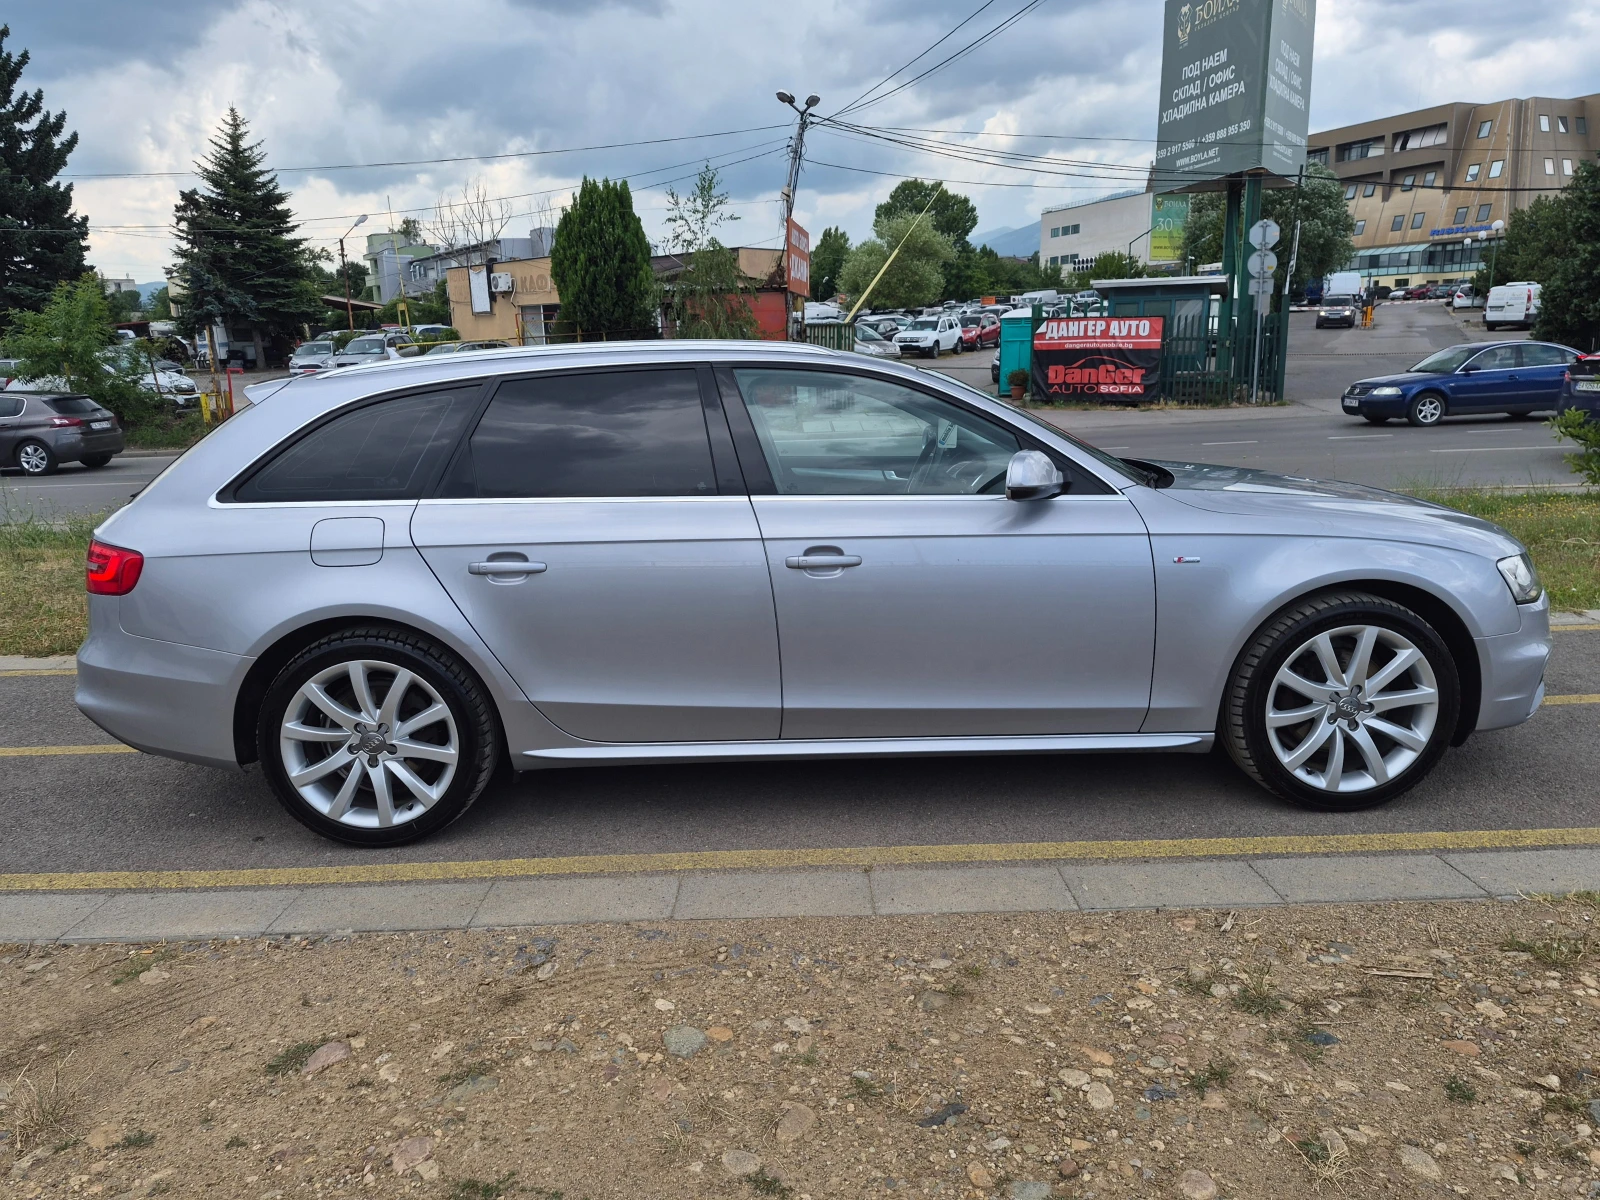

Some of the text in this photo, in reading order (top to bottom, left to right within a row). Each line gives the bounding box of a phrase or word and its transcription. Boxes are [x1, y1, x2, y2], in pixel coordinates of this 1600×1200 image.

[1182, 48, 1228, 80] ПОД НАЕМ
[1172, 82, 1201, 103] СКЛАД
[1208, 65, 1236, 89] ОФИС
[1161, 80, 1245, 125] ХЛАДИЛНА КАМЕРА
[1171, 143, 1181, 155] 917
[1201, 131, 1215, 144] +359
[1216, 127, 1227, 140] 888
[1227, 123, 1238, 136] 955
[1239, 119, 1251, 132] 350
[1156, 217, 1173, 232] 30
[1045, 319, 1150, 340] ДАНГЕР АУТО
[1047, 364, 1146, 384] DanGer
